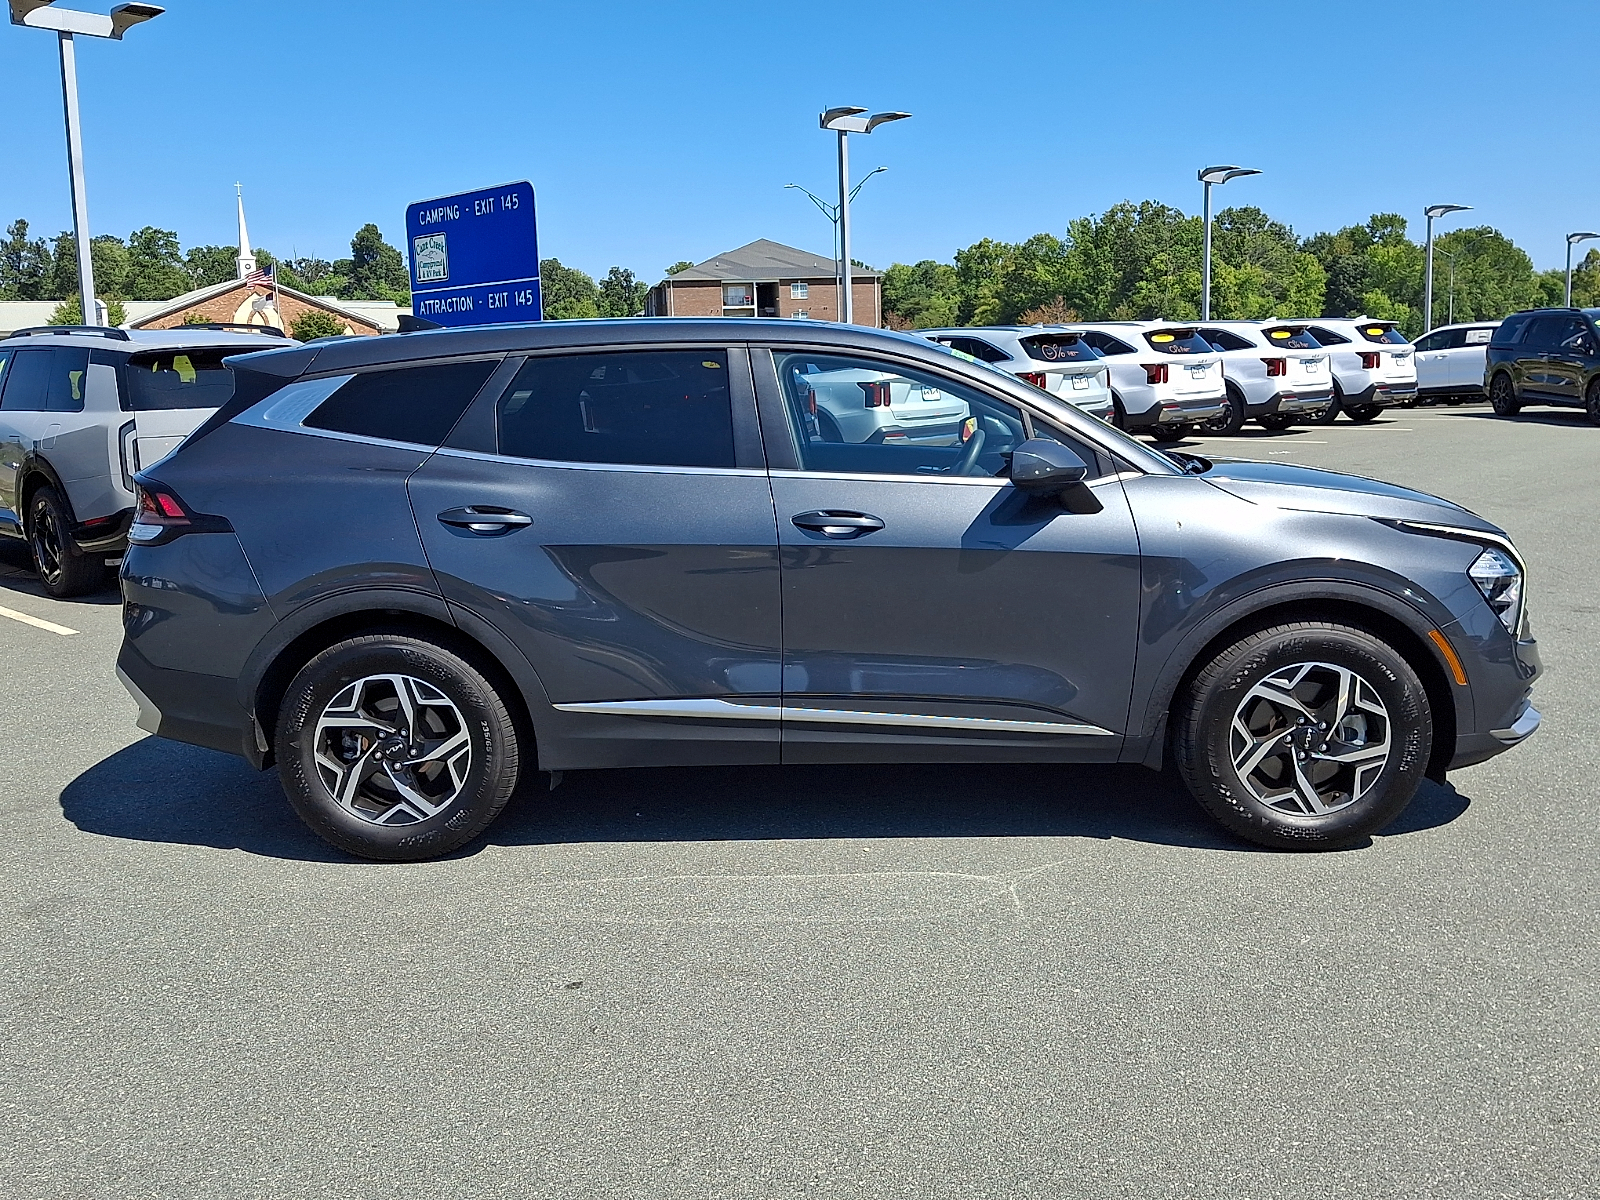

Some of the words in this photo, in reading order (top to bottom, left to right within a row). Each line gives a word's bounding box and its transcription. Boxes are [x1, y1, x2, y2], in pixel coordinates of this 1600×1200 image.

[419, 205, 460, 226] CAMPING
[474, 198, 495, 216] EXIT
[500, 193, 519, 211] 145
[429, 237, 445, 254] Creek
[419, 296, 474, 315] ATTRACTION
[488, 292, 508, 309] EXIT
[514, 289, 533, 307] 145
